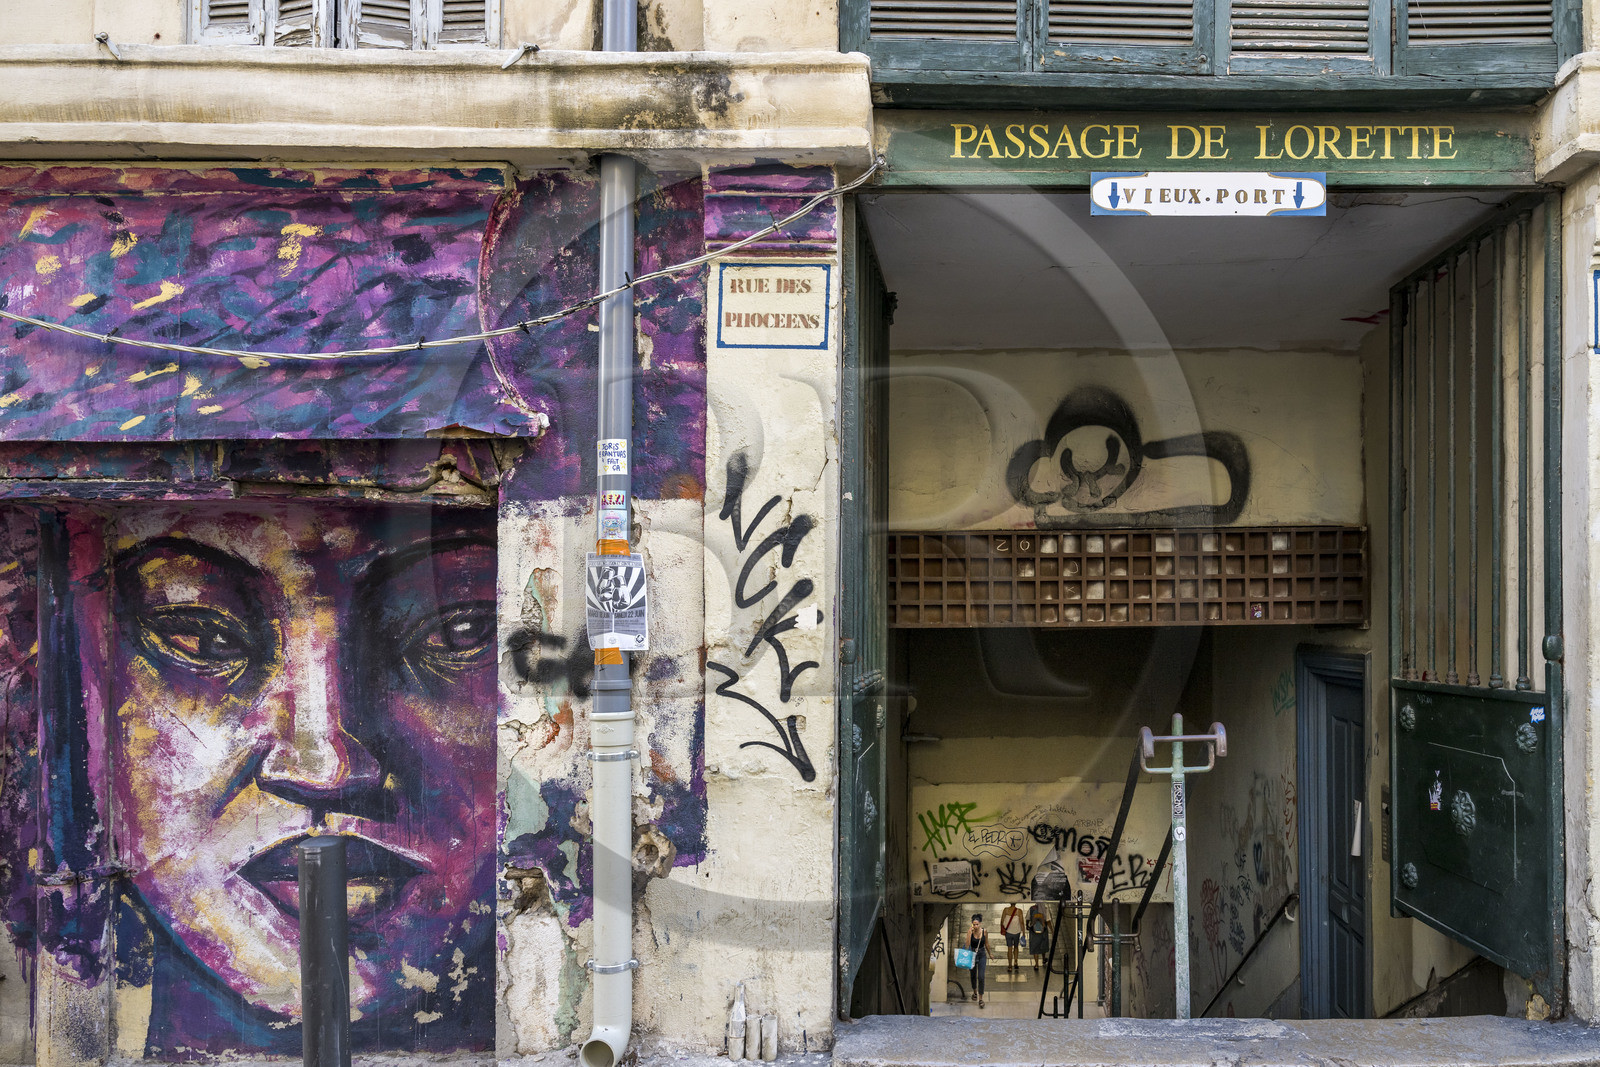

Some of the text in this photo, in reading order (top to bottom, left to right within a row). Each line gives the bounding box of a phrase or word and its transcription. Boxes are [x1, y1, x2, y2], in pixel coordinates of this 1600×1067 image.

[950, 123, 1458, 160] PASSAGE DE LORETTE
[730, 278, 812, 294] RUE DES
[725, 311, 820, 330] PHOCEENS
